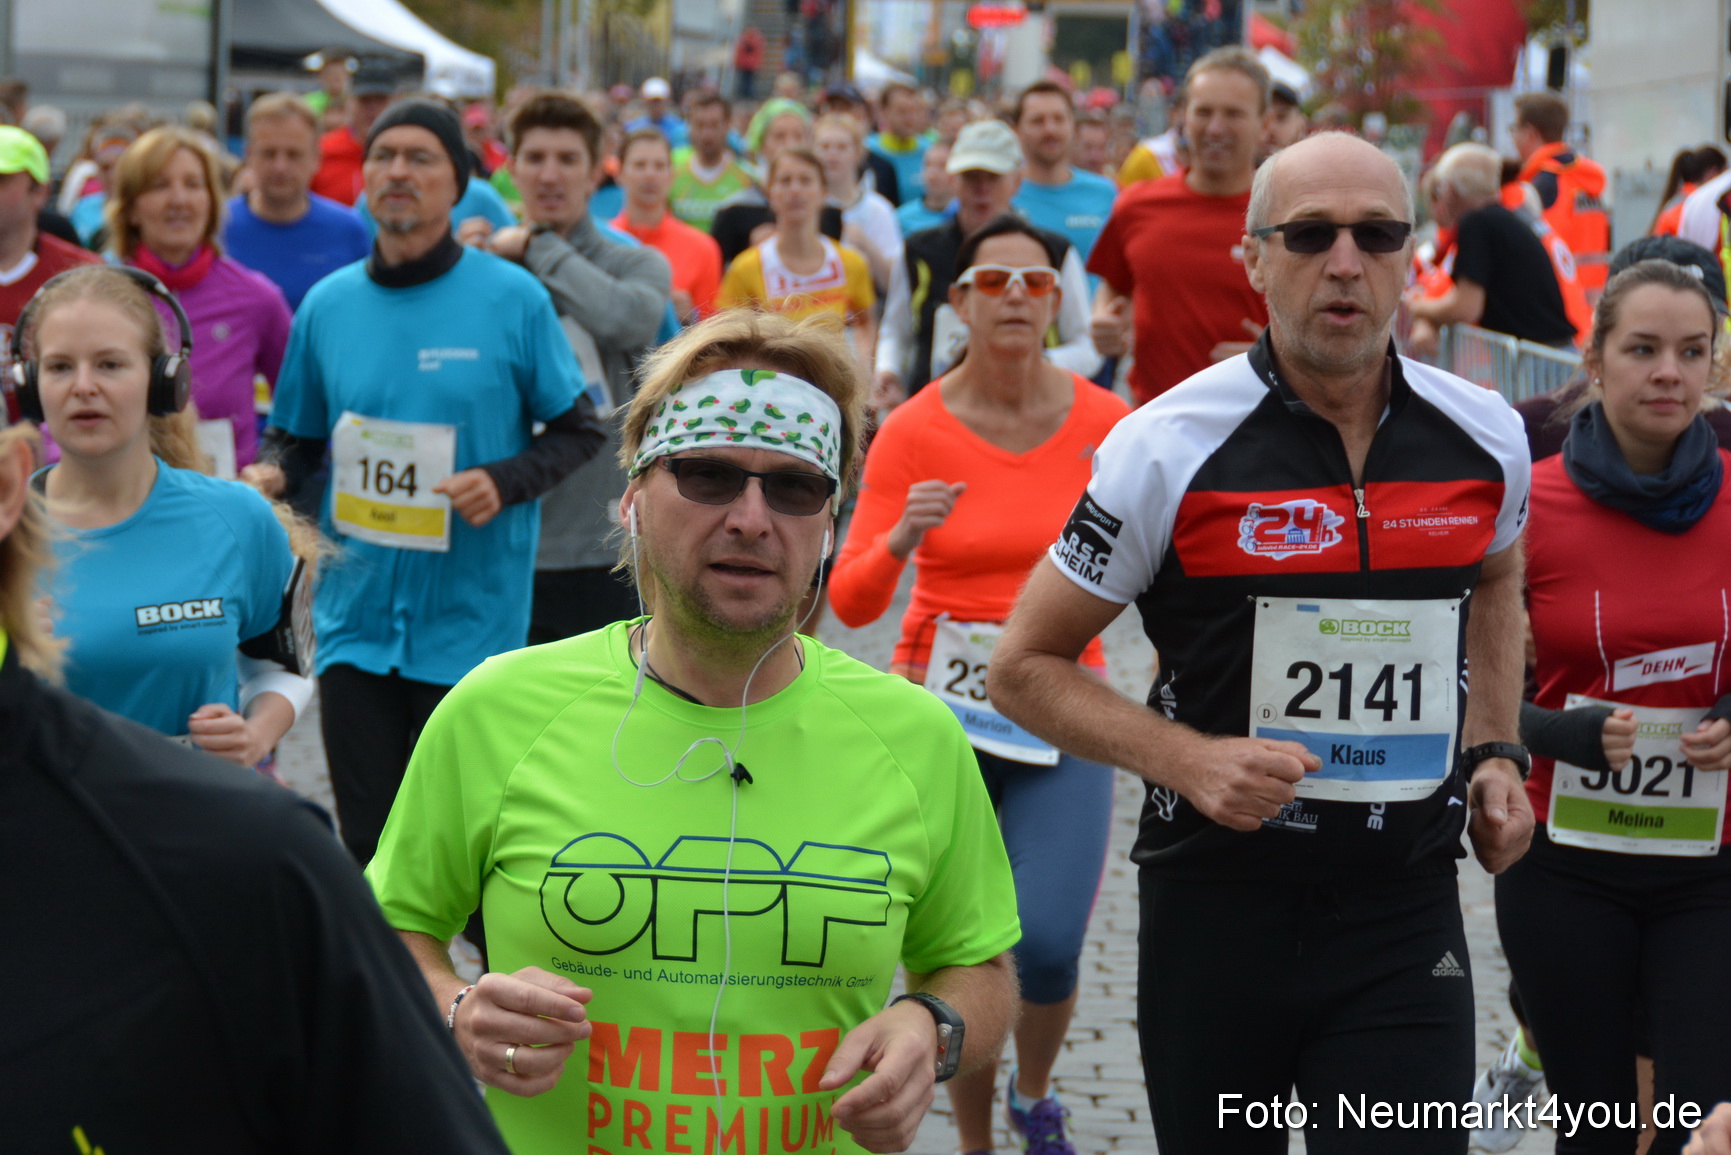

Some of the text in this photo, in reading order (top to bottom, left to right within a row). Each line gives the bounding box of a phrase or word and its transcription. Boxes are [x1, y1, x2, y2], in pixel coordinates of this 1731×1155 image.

[358, 457, 418, 498] 164
[1383, 515, 1478, 529] 24 STUNDEN RENNEN
[1055, 536, 1104, 585] LHEIM
[1068, 531, 1110, 567] RSC
[135, 597, 225, 628] BOCK
[1341, 619, 1411, 637] BOCK
[1641, 656, 1687, 676] DEHN
[944, 659, 988, 701] 23
[1284, 660, 1423, 721] 2141
[963, 711, 1012, 735] Marion
[1637, 722, 1683, 736] OCK
[1330, 743, 1386, 766] Klaus
[1293, 812, 1319, 824] BAU
[1608, 809, 1665, 829] Melina
[551, 956, 617, 977] Gebäude-
[623, 967, 653, 981] und
[846, 974, 876, 989] GmbH
[1432, 967, 1465, 977] adidas
[587, 1020, 841, 1098] MERZ
[587, 1090, 838, 1155] PREMIUM
